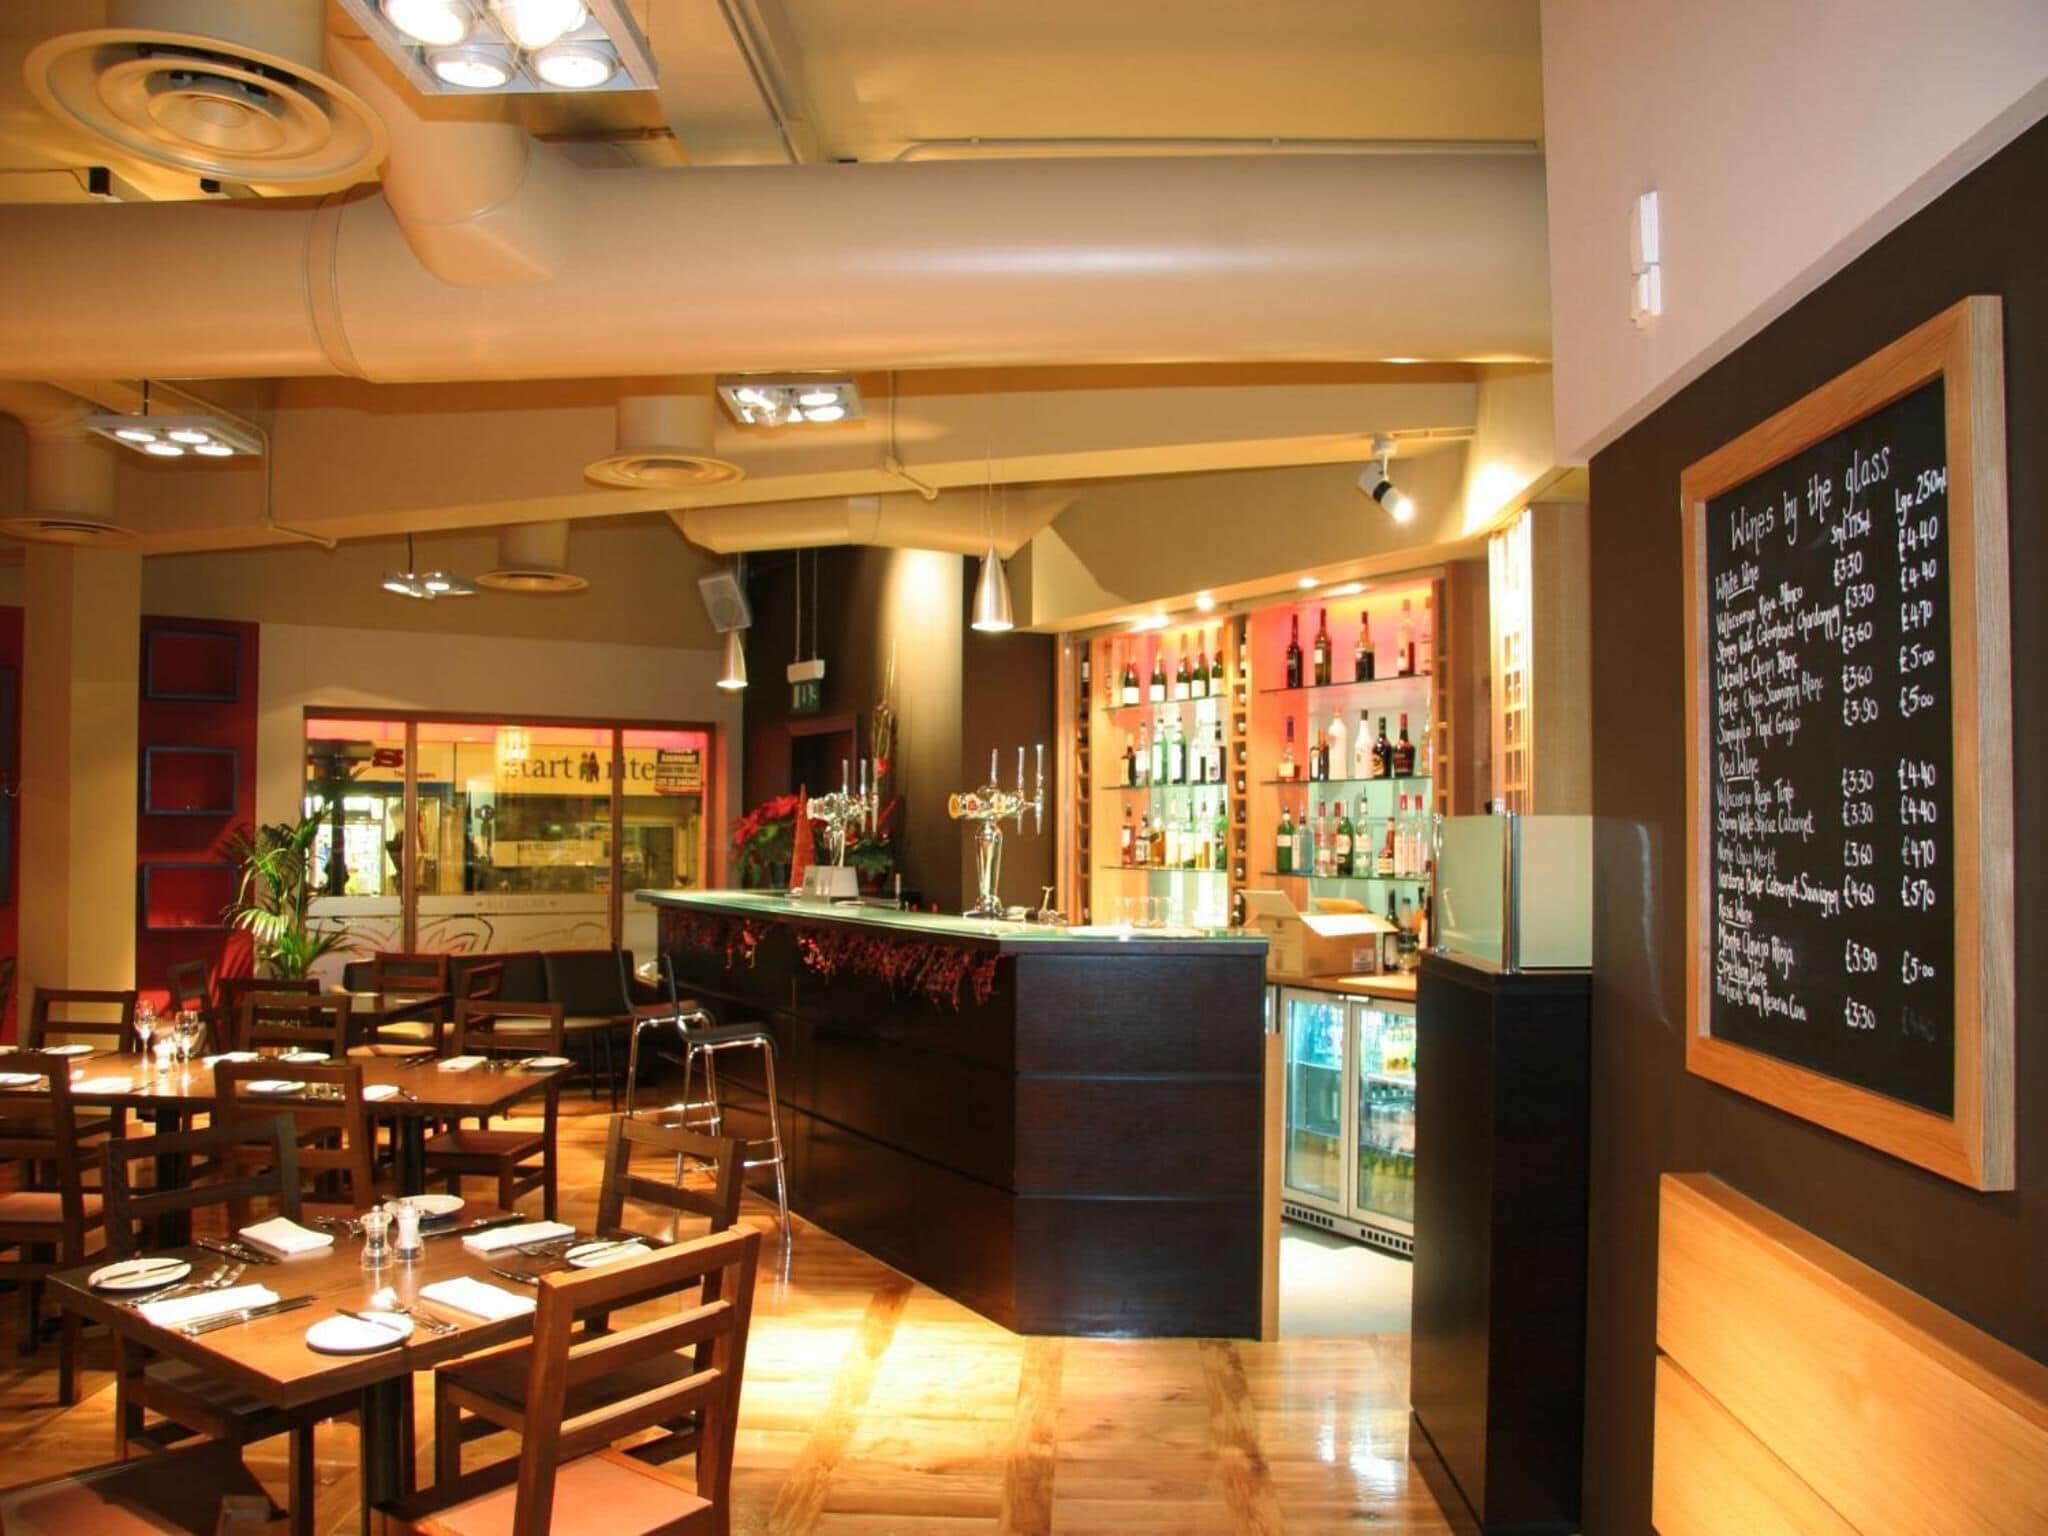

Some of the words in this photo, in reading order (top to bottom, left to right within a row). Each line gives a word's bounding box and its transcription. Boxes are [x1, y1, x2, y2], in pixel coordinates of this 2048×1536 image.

[1731, 503, 1775, 555] Wines
[1783, 491, 1798, 546] by
[1807, 473, 1832, 524] the
[1845, 446, 1890, 518] glass
[1719, 752, 1735, 781] Red
